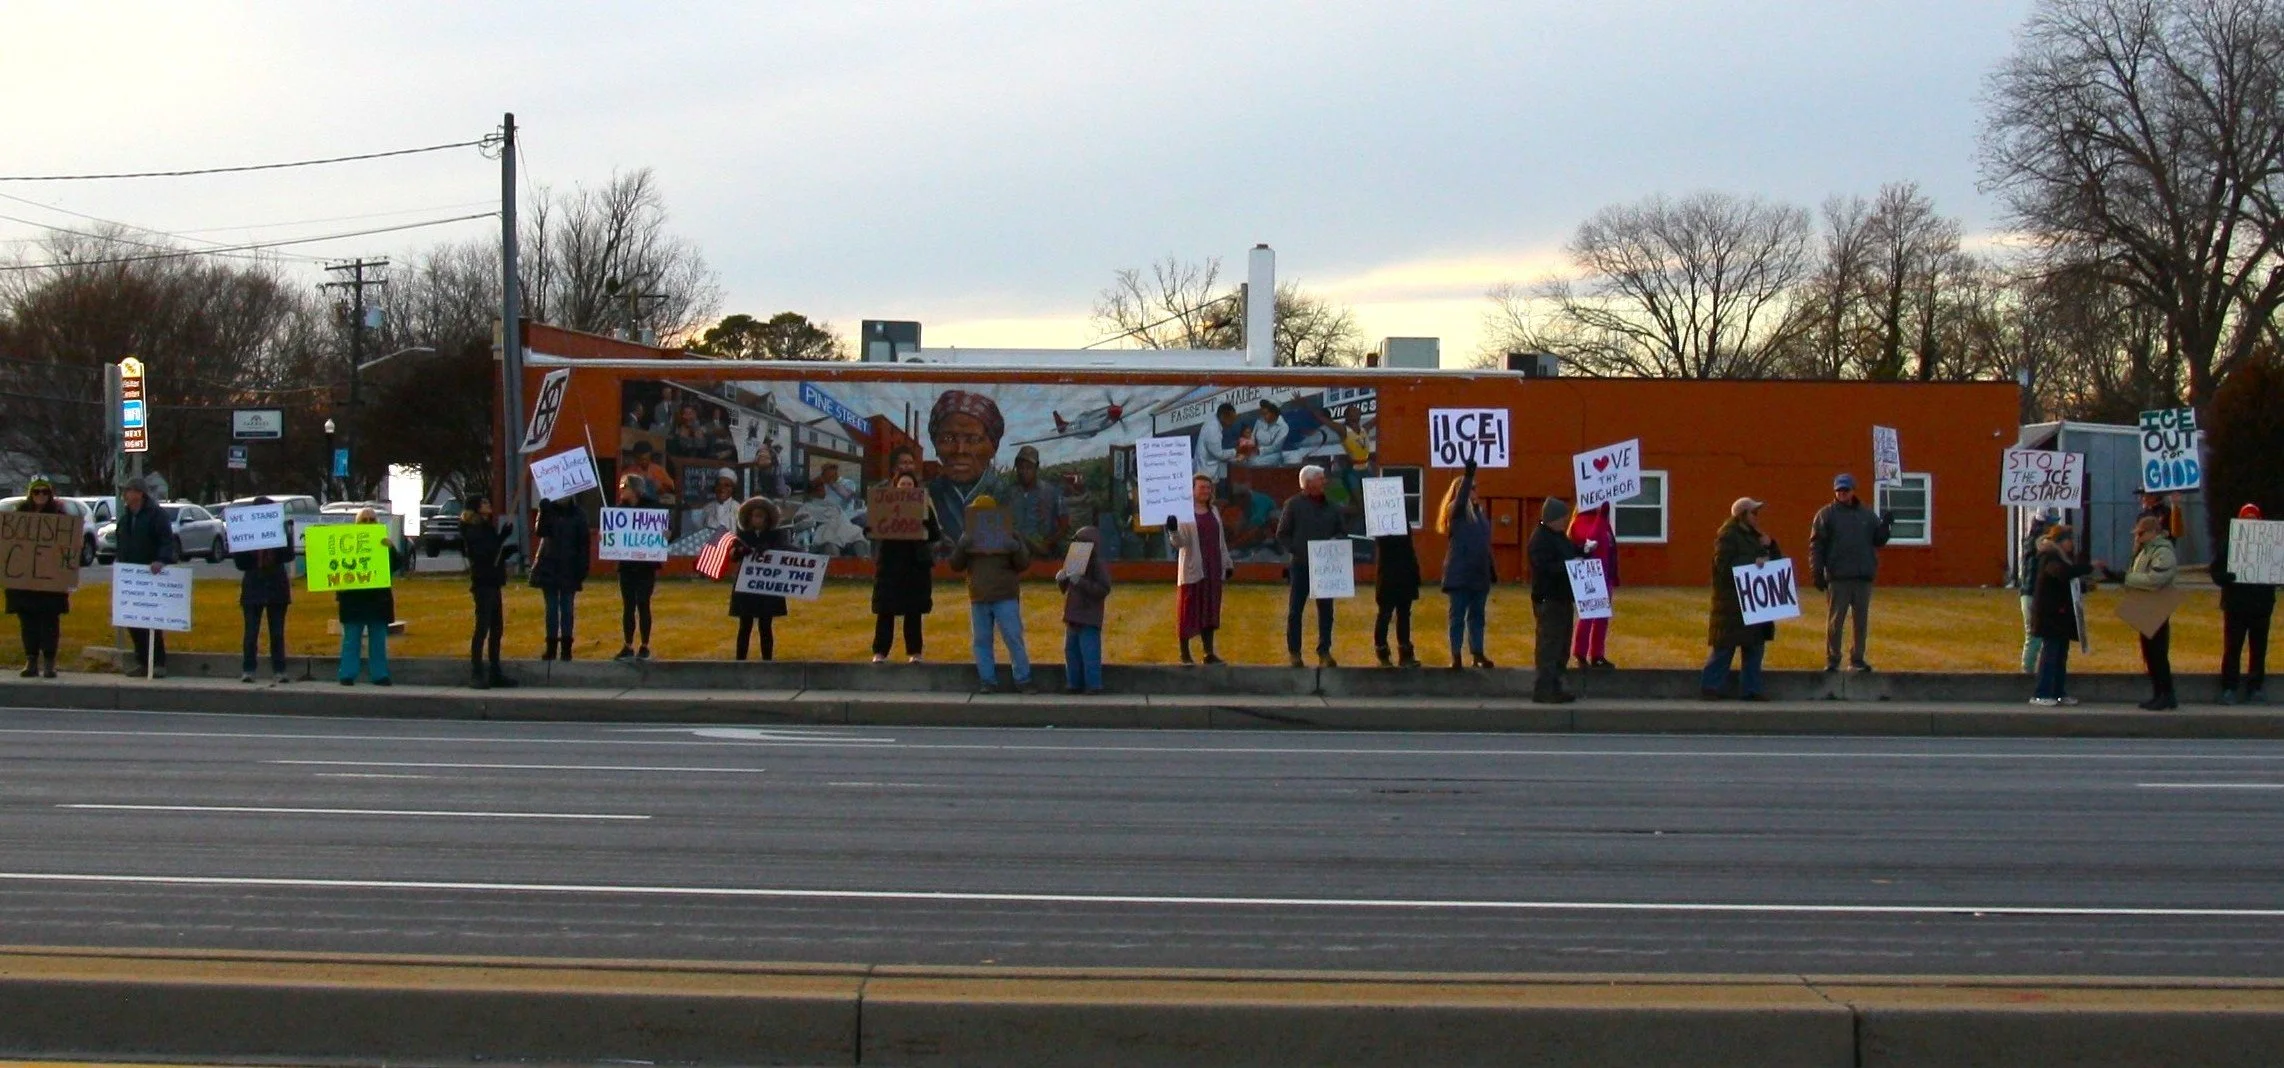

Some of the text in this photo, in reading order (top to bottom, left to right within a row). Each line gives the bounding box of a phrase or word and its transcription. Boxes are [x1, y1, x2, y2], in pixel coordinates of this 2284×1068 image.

[806, 386, 833, 414] PINE
[1171, 398, 1217, 423] FASSETT
[2141, 408, 2195, 431] ICE
[2144, 429, 2196, 452] OUT
[2009, 451, 2076, 469] STOP
[2161, 450, 2184, 461] for
[562, 469, 593, 490] ALL
[1600, 473, 1618, 485] THY
[2012, 469, 2072, 485] THE ICE
[2145, 459, 2200, 488] GOOD
[1580, 480, 1634, 506] NEIGHBOR
[251, 512, 279, 521] STAND
[603, 511, 669, 531] NO HUMAN
[231, 533, 254, 543] WITH
[327, 532, 372, 556] ICE
[603, 532, 669, 548] IS ILLEGAL
[329, 556, 371, 571] OUT
[750, 551, 816, 568] ICE KILLS
[745, 566, 814, 582] STOP THE
[1568, 560, 1602, 580] WE ARE
[747, 579, 808, 595] CRUELTY
[1735, 567, 1796, 613] HONK
